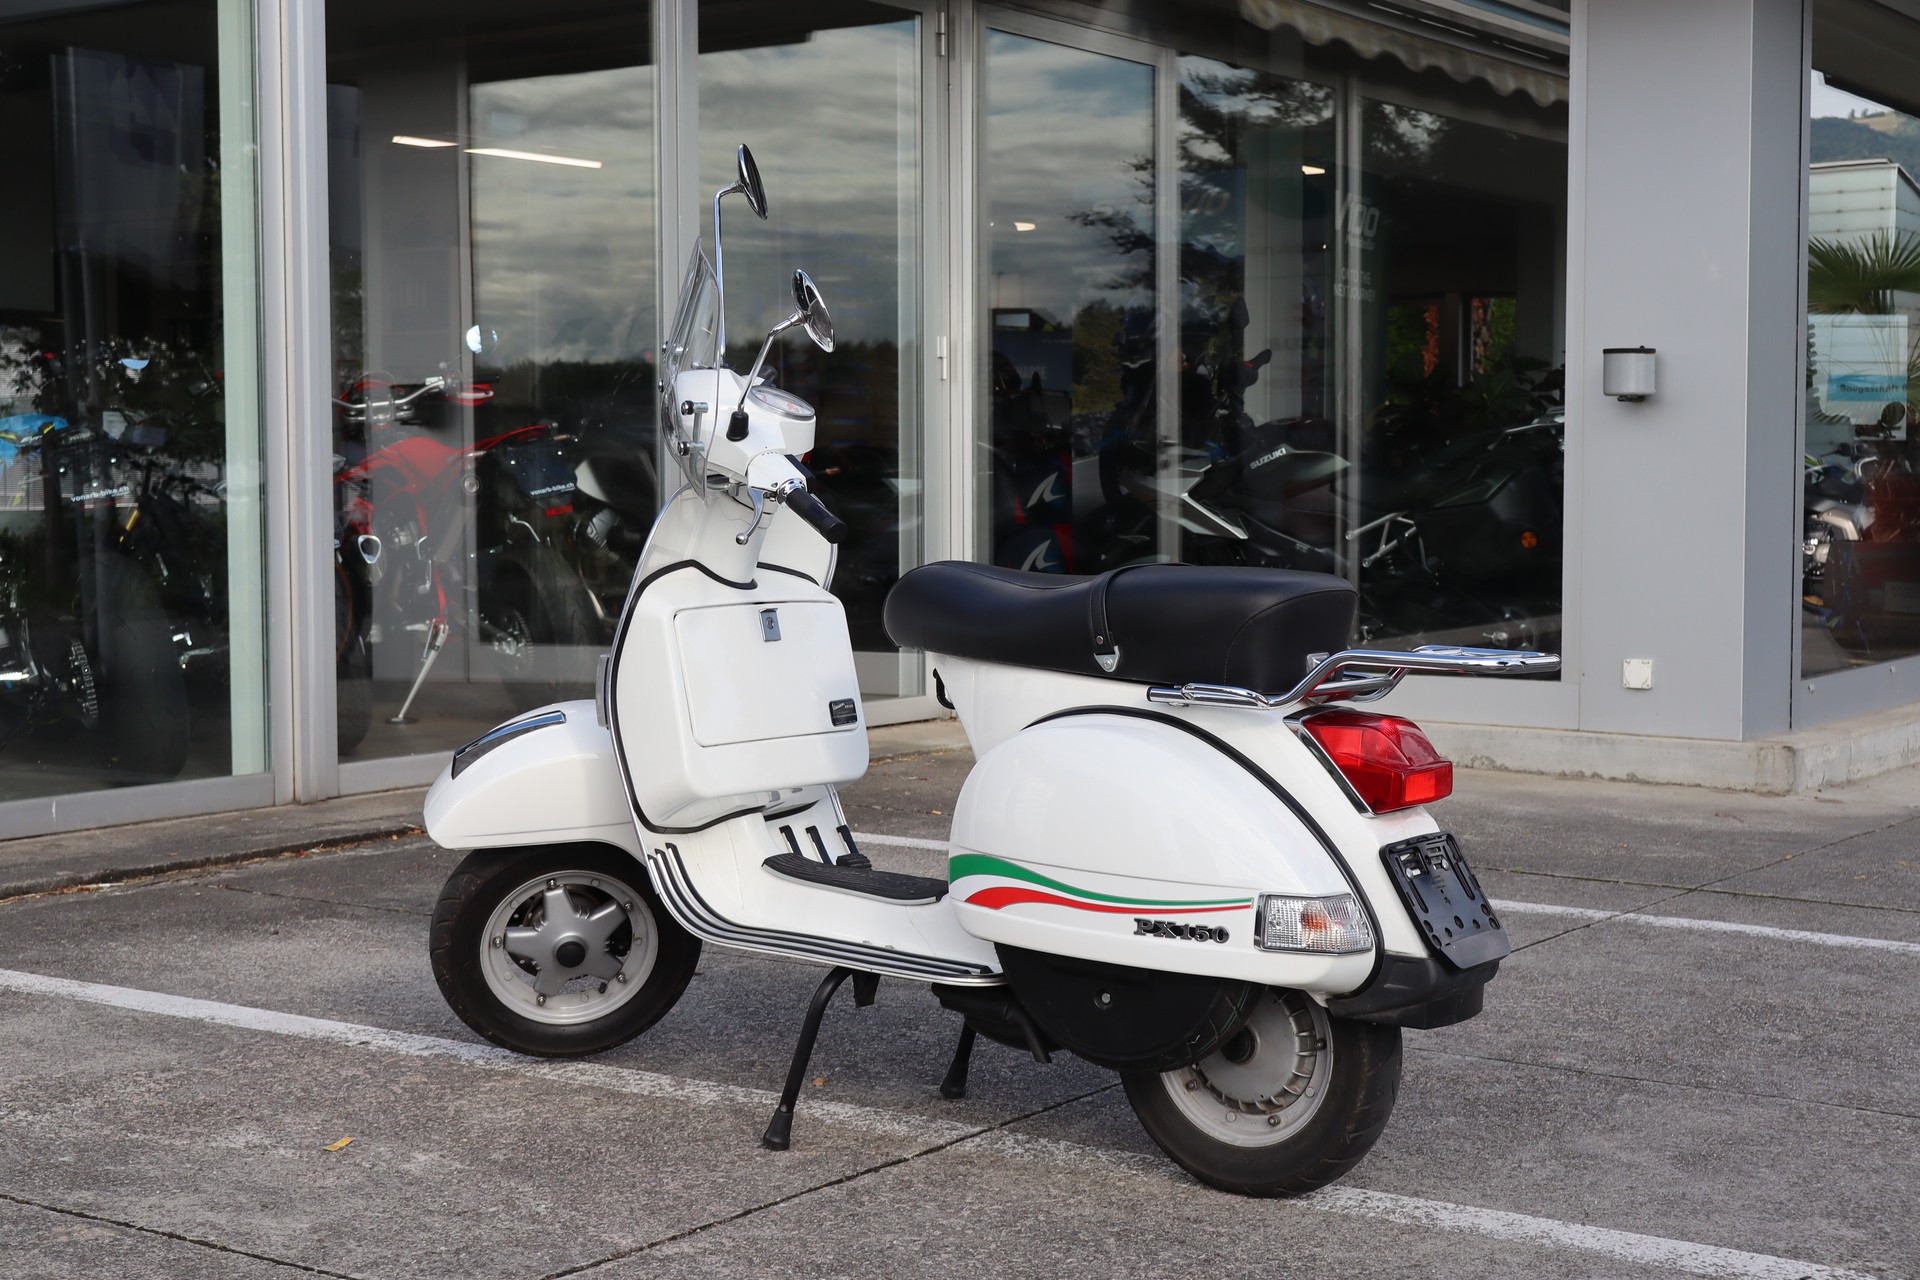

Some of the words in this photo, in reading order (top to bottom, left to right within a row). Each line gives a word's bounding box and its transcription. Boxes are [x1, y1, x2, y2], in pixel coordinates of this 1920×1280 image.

[1249, 447, 1287, 470] SUZUKI
[70, 486, 130, 503] vonarb-bike.ch
[530, 482, 575, 496] vonarb-bike.ch
[1133, 918, 1230, 944] PX150
